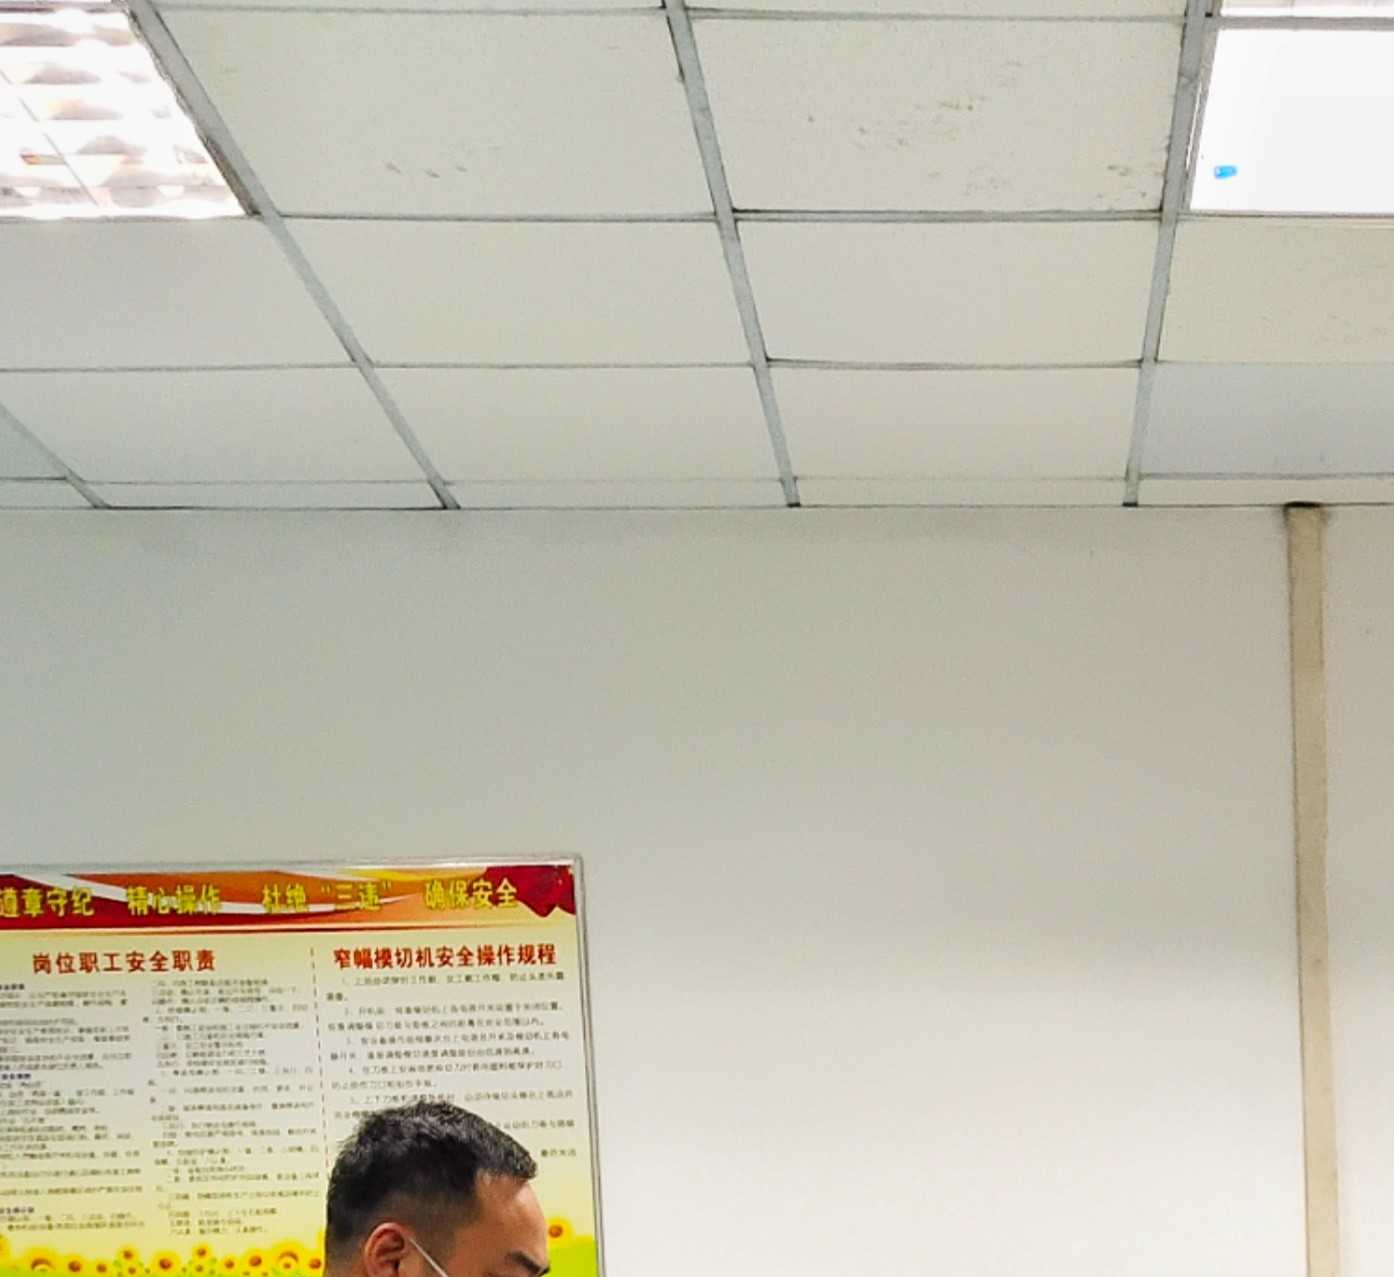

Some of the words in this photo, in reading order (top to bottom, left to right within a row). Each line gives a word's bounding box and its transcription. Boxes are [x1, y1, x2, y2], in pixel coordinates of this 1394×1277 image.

[126, 884, 221, 916] 精心操作
[425, 878, 518, 910] 确保安全
[32, 949, 216, 974] 岗位职工安全职责
[333, 943, 557, 970] 窄幅模切机安全操作规程
